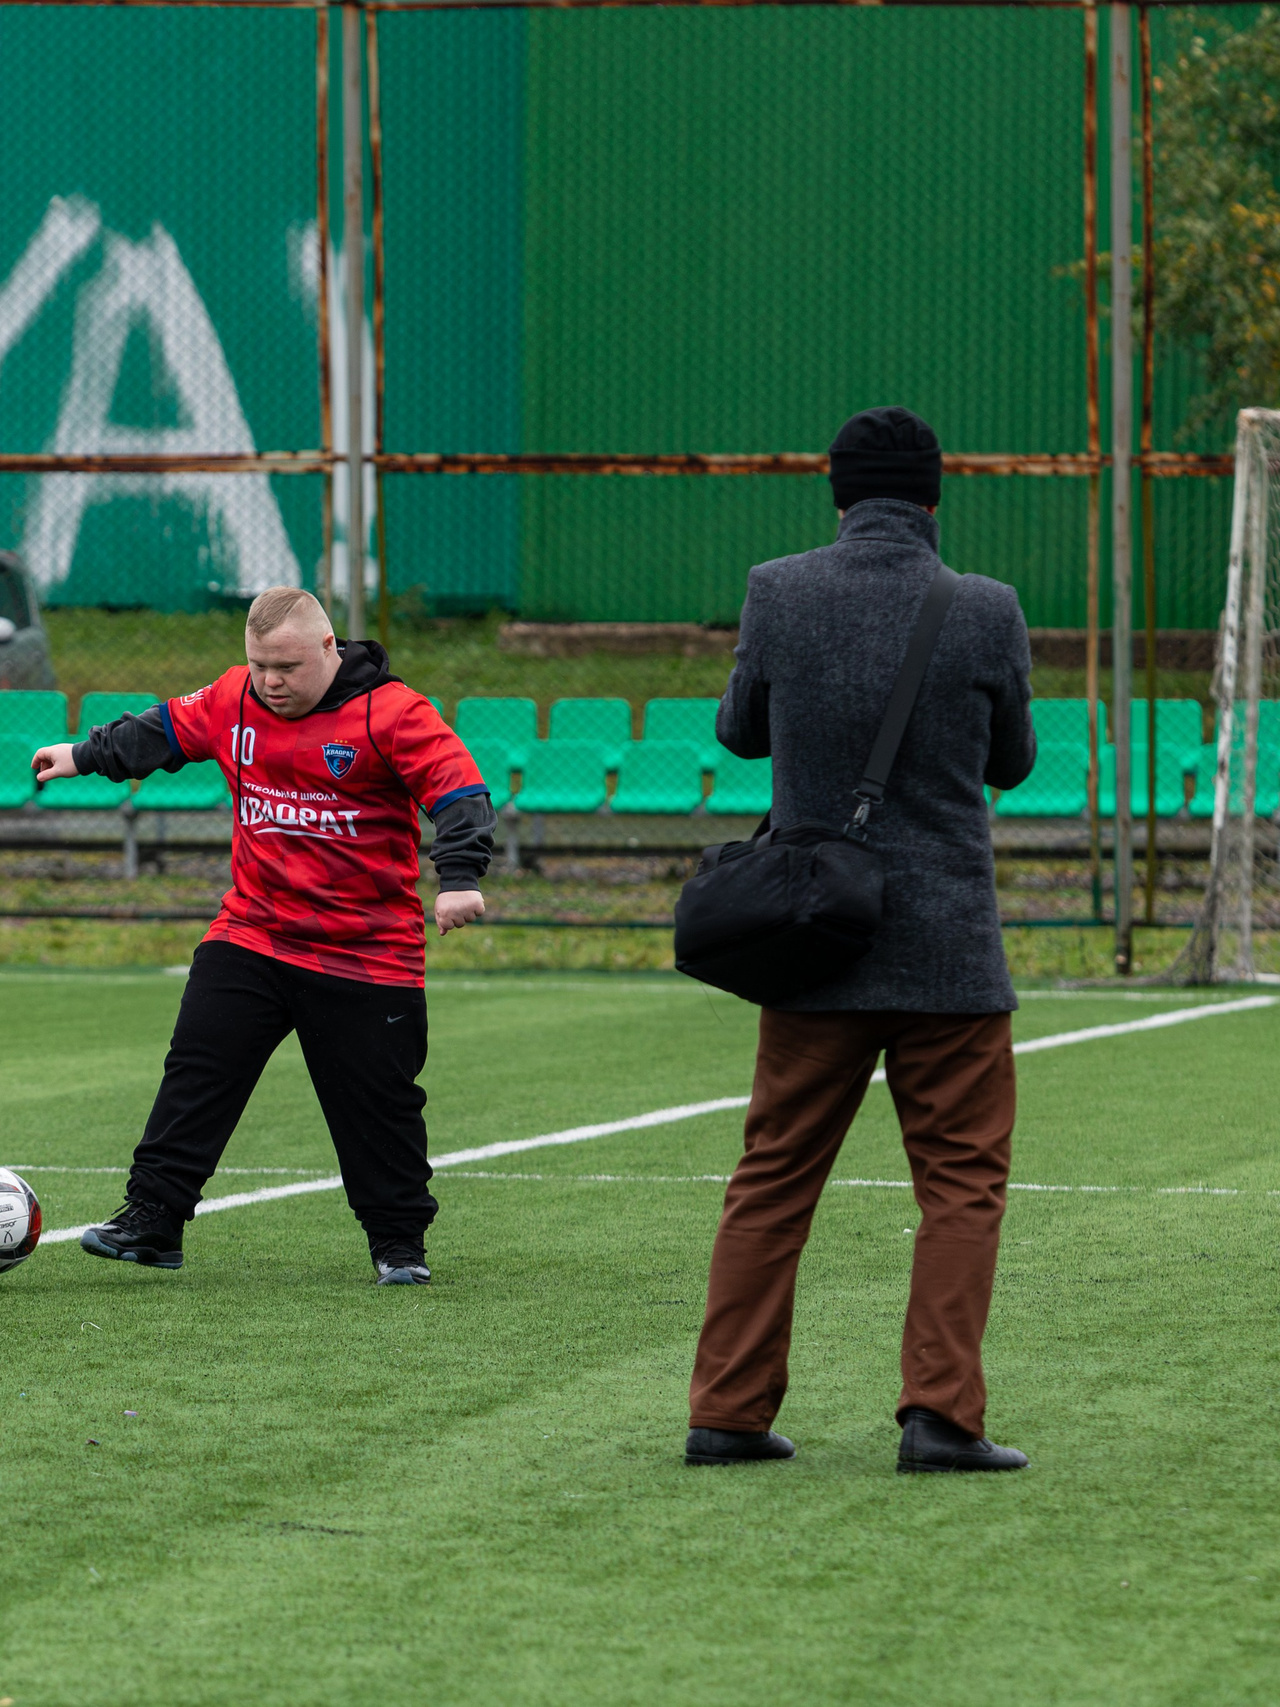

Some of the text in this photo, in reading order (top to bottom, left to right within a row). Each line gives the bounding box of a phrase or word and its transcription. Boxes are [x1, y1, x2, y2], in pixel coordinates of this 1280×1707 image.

[231, 724, 256, 766] 10
[242, 782, 339, 802] УТБОЛЬНАЯ ШКОЛА
